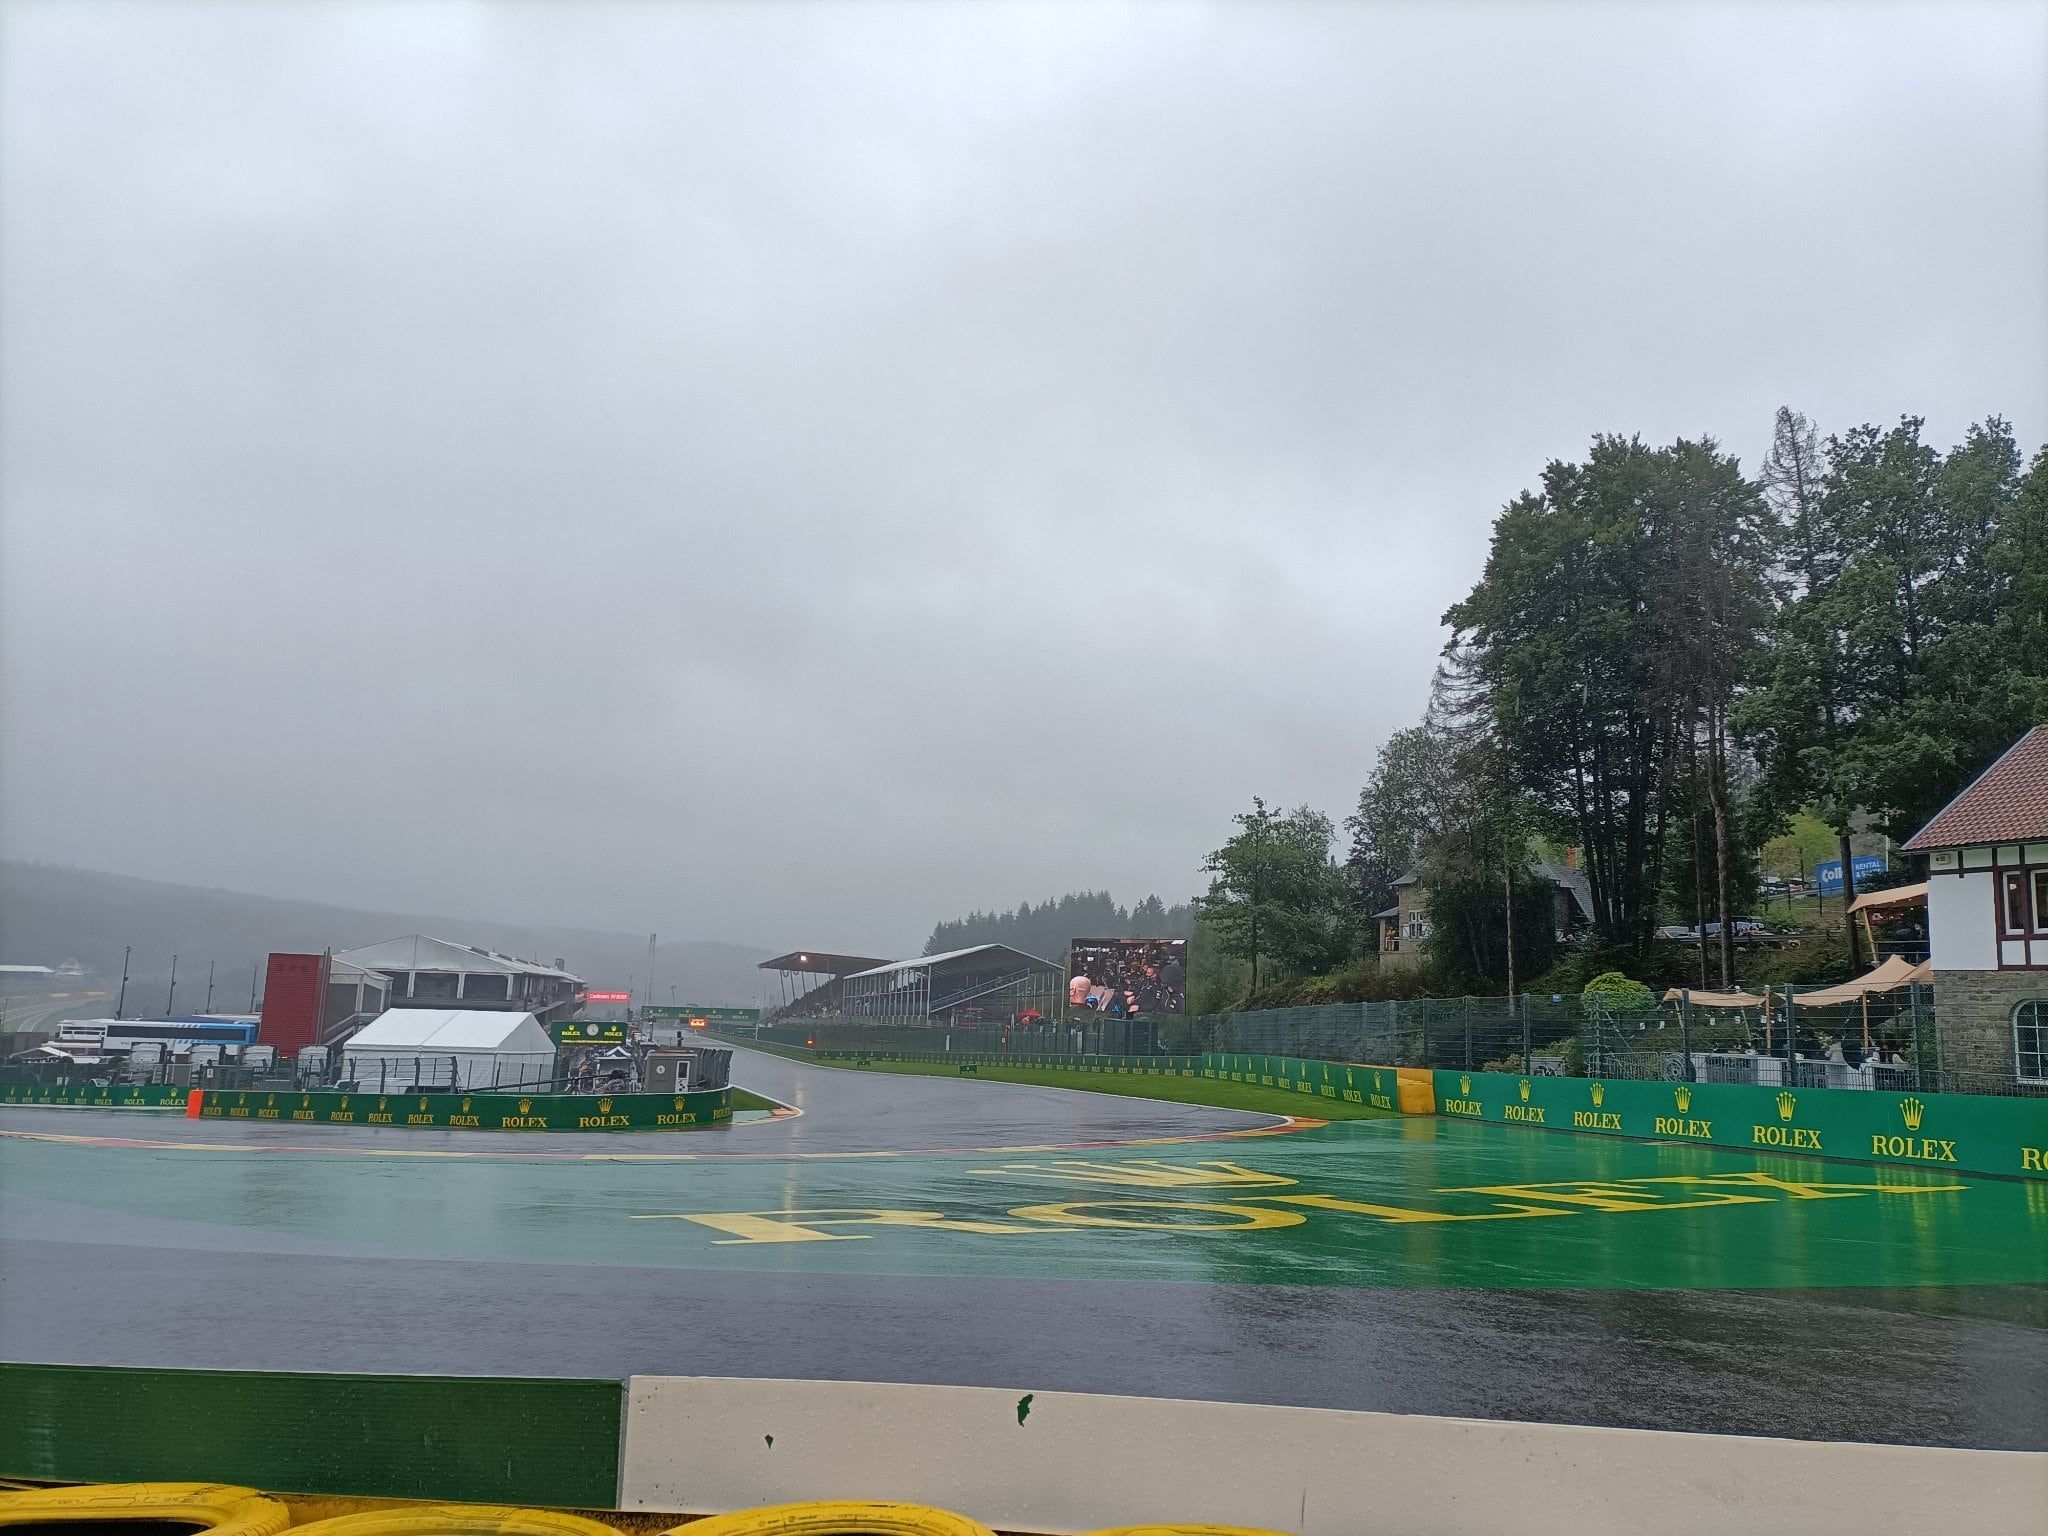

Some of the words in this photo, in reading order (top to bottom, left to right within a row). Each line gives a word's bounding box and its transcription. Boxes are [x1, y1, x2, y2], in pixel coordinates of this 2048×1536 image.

[1856, 861, 1881, 871] RENTAL
[1342, 1089, 1362, 1103] ROLEX
[1370, 1093, 1391, 1109] ROLEX
[95, 1098, 113, 1106] ROLEX
[124, 1098, 146, 1106] ROLEX
[160, 1098, 186, 1106] ROLEX
[1445, 1098, 1482, 1116] ROLEX
[204, 1107, 222, 1116] ROLEX
[230, 1107, 250, 1117] ROLEX
[258, 1109, 280, 1119] ROLEX
[293, 1110, 316, 1120] ROLEX
[330, 1111, 354, 1122] ROLEX
[1504, 1105, 1546, 1123] ROLEX
[368, 1113, 393, 1123] ROLEX
[407, 1114, 434, 1124] ROLEX
[449, 1115, 480, 1127] ROLEX
[502, 1117, 548, 1128] ROLEX
[578, 1116, 630, 1128] ROLEX
[657, 1112, 697, 1125] ROLEX
[1573, 1111, 1622, 1130] ROLEX
[1654, 1117, 1712, 1139] ROLEX
[1752, 1125, 1822, 1149] ROLEX
[1871, 1135, 1958, 1162] ROLEX
[631, 1171, 1973, 1245] ROLEX
